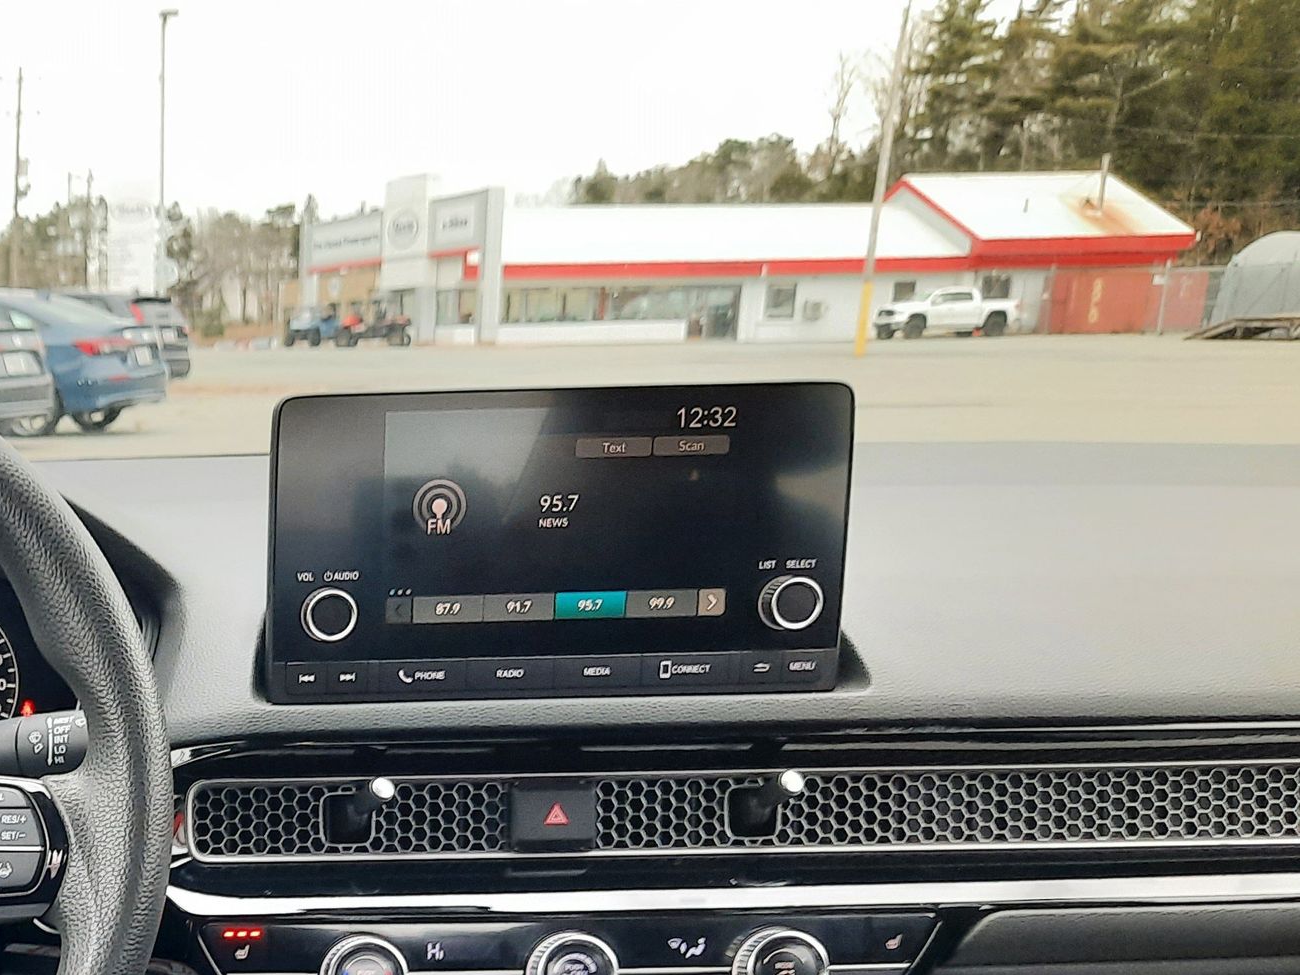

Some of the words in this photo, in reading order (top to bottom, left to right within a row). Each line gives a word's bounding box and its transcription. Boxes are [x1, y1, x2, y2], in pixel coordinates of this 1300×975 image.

[677, 406, 737, 429] 12:32
[602, 442, 626, 454] Text
[678, 440, 705, 452] Scan
[540, 494, 579, 513] 95.7
[427, 519, 451, 535] FM
[538, 518, 569, 528] NEWS
[758, 560, 777, 569] LIST
[785, 559, 818, 569] SELECT
[297, 572, 315, 582] VOL
[333, 571, 360, 581] AUDIO
[435, 602, 461, 616] 87.9
[506, 600, 533, 614] 91.7
[578, 598, 603, 612] 95.7
[648, 597, 675, 610] 99.9
[583, 666, 611, 677] MEDIA
[671, 663, 712, 675] CONNECT
[789, 661, 817, 671] MENU
[414, 670, 446, 681] PHONE
[496, 669, 525, 679] RADIO
[53, 725, 71, 734] OFF
[53, 734, 69, 744] INT
[53, 744, 67, 755] LO
[53, 755, 65, 764] HI
